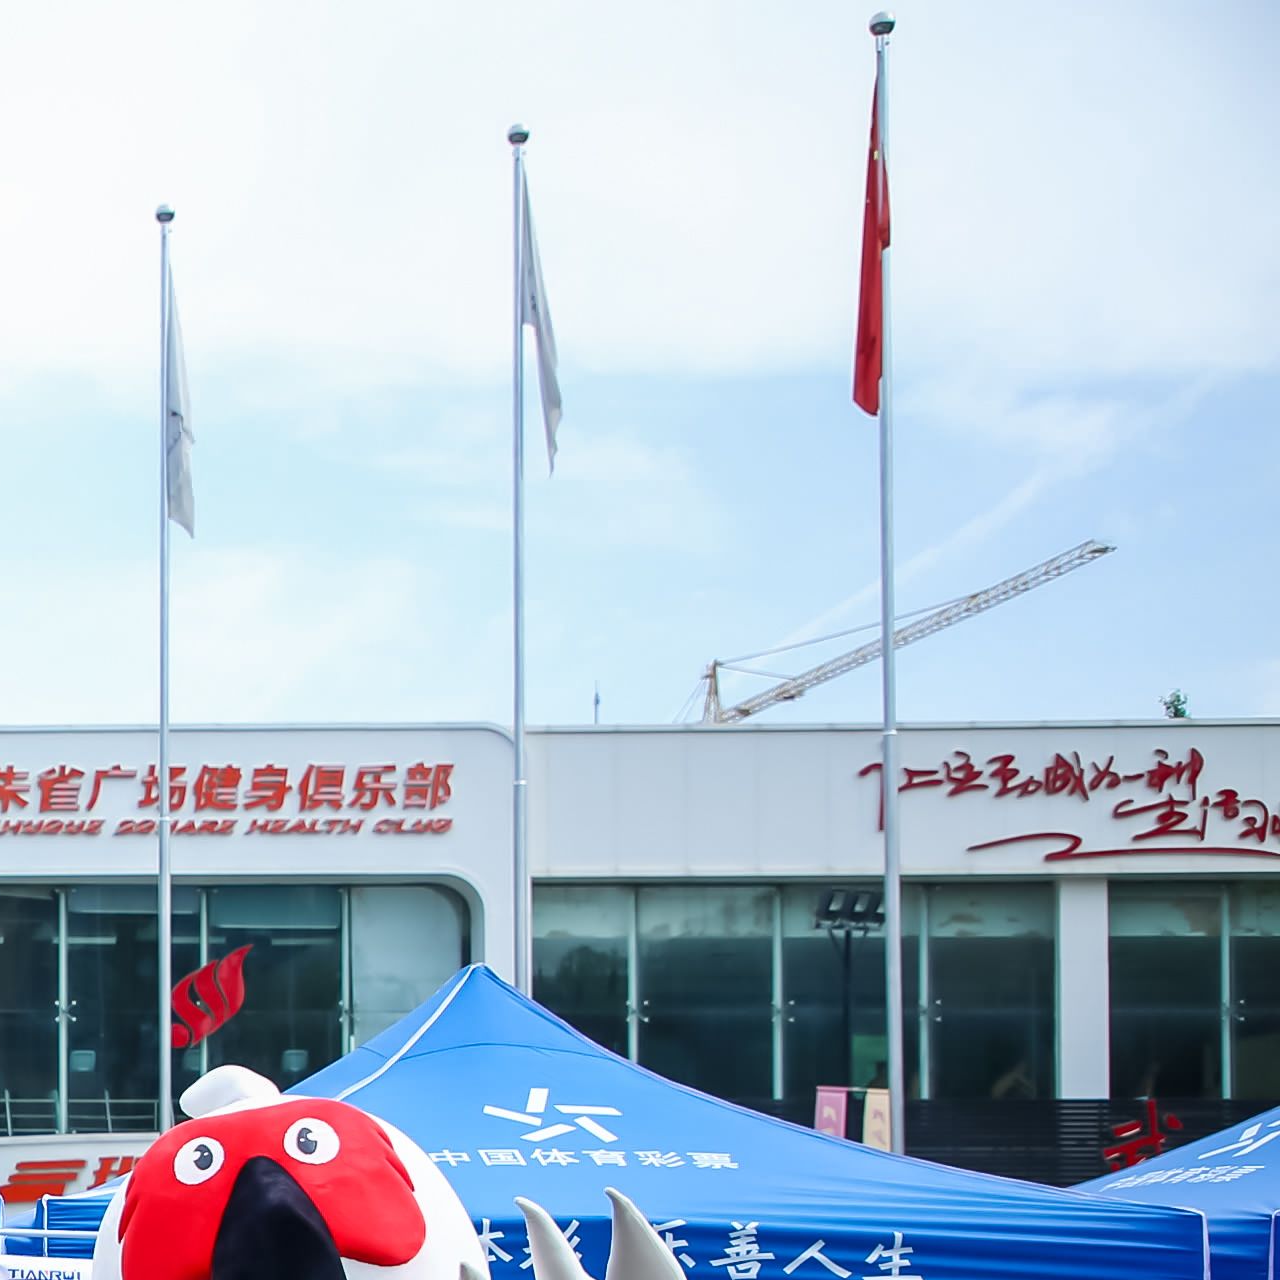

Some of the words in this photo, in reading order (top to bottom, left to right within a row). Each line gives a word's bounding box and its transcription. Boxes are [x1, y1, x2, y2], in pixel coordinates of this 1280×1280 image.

[1112, 788, 1280, 842] 生活习
[244, 818, 364, 836] HEALTH
[426, 1148, 739, 1169] 中国体育彩票
